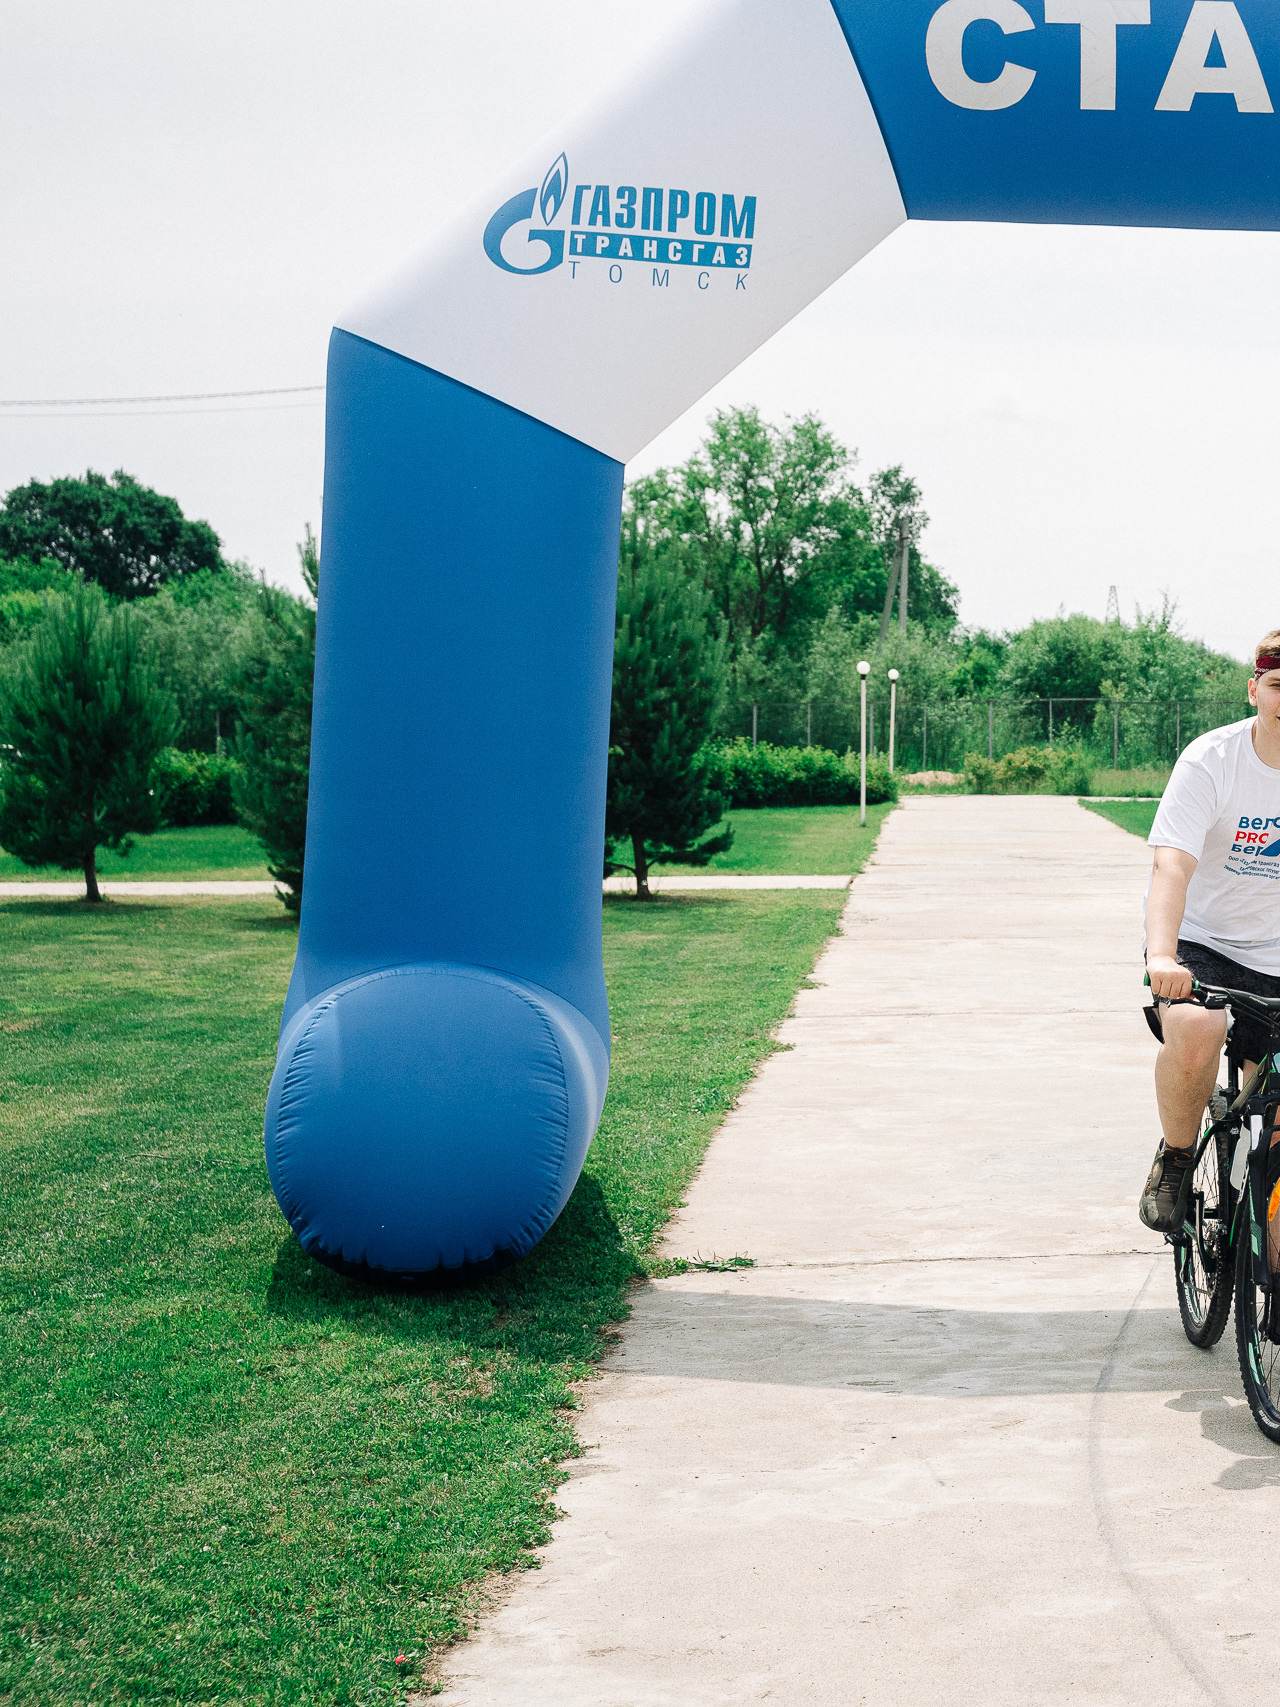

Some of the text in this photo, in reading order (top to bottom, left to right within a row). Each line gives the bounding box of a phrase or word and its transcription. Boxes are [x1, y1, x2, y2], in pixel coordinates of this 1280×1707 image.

[571, 184, 757, 239] ГАЗПРОМ
[573, 233, 748, 266] ТРАНСГАЗ
[568, 260, 749, 290] ТОМСК
